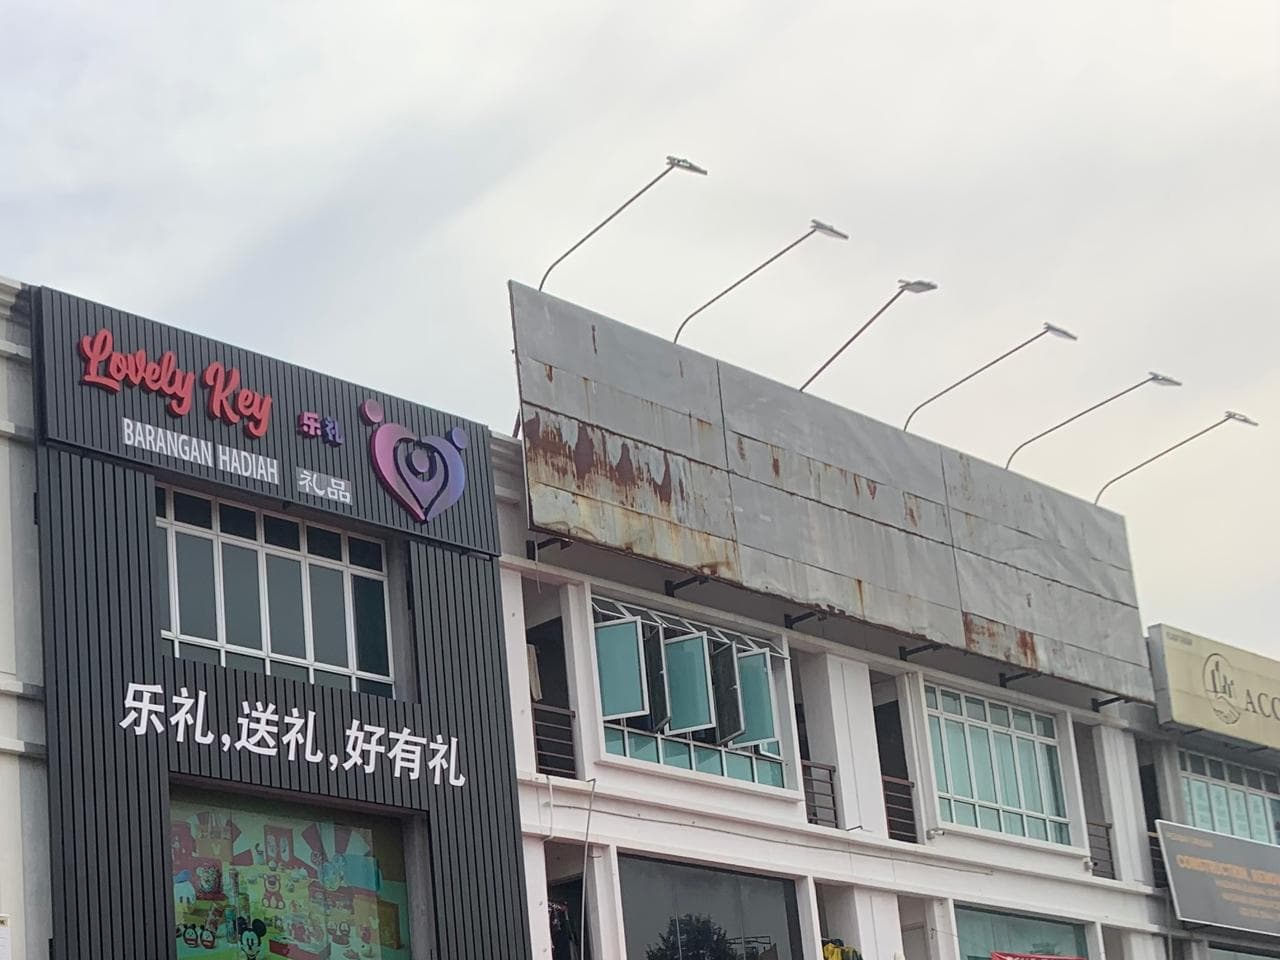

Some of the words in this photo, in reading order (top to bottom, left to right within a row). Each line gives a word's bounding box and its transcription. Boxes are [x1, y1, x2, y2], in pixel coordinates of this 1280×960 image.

[80, 329, 195, 416] Lovely
[204, 362, 272, 438] Key
[123, 418, 212, 467] BARANGAN
[219, 444, 279, 485] HADIAH
[299, 411, 344, 446] 乐礼
[298, 470, 351, 504] 礼品
